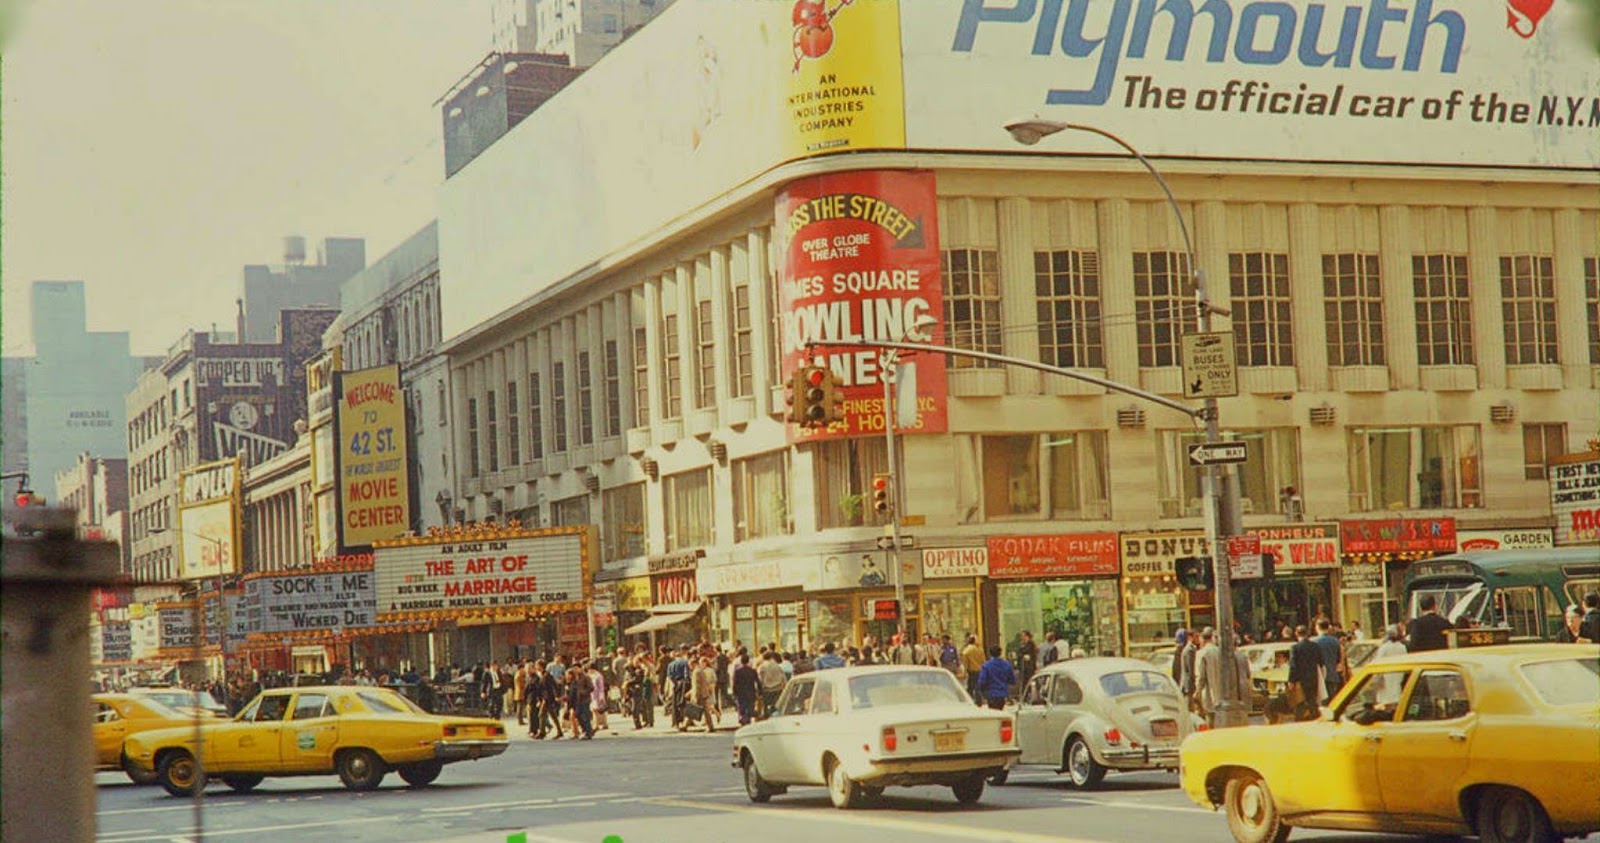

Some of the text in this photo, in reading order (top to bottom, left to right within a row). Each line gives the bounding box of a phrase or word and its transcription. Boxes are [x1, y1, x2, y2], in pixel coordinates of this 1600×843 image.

[951, 0, 1466, 105] Plymouth
[819, 73, 837, 85] AN
[1123, 76, 1186, 109] The
[1195, 80, 1344, 116] official
[1348, 96, 1415, 118] car
[1420, 89, 1464, 120] of
[1469, 93, 1531, 124] the
[793, 101, 864, 119] INDUSTRIES
[799, 117, 854, 132] COMPANY
[811, 194, 846, 220] THE
[849, 194, 916, 240] STREET
[802, 233, 870, 252] OVER GLOBE
[809, 245, 860, 262] THEATRE
[832, 269, 921, 294] SQUARE
[783, 296, 932, 357] OWLING
[1193, 354, 1224, 364] BUSES
[1207, 369, 1231, 379] ONLY
[345, 381, 395, 409] WELCOME
[363, 411, 378, 424] TO
[858, 413, 924, 431] HOS
[350, 427, 396, 455] 42 ST.
[1198, 448, 1243, 458] ONE WAY
[1556, 462, 1600, 478] FIRST NE
[350, 478, 398, 503] MOVIE
[1554, 490, 1596, 503] SOMETHING
[348, 504, 403, 529] CENTER
[441, 542, 508, 554] AN ADULT FILM
[989, 537, 1115, 556] KODAK FILMS
[1126, 538, 1209, 557] DONUT
[1503, 533, 1550, 545] GARDEN
[312, 553, 376, 571] VICTORY
[925, 549, 985, 569] OPTIMO
[1288, 541, 1336, 565] WEAR
[425, 555, 529, 577] THE ART OF
[934, 566, 978, 576] CIGARS
[1127, 561, 1162, 572] COFFEE
[272, 577, 316, 595] SOCK
[342, 574, 369, 591] ME
[398, 584, 438, 595] BIG WEEK
[443, 576, 537, 598] MARRIAGE
[391, 592, 568, 611] A MARRIAGE MANUAL IN LIVING COLOR
[290, 612, 339, 628] WICKED
[344, 610, 368, 625] DIE
